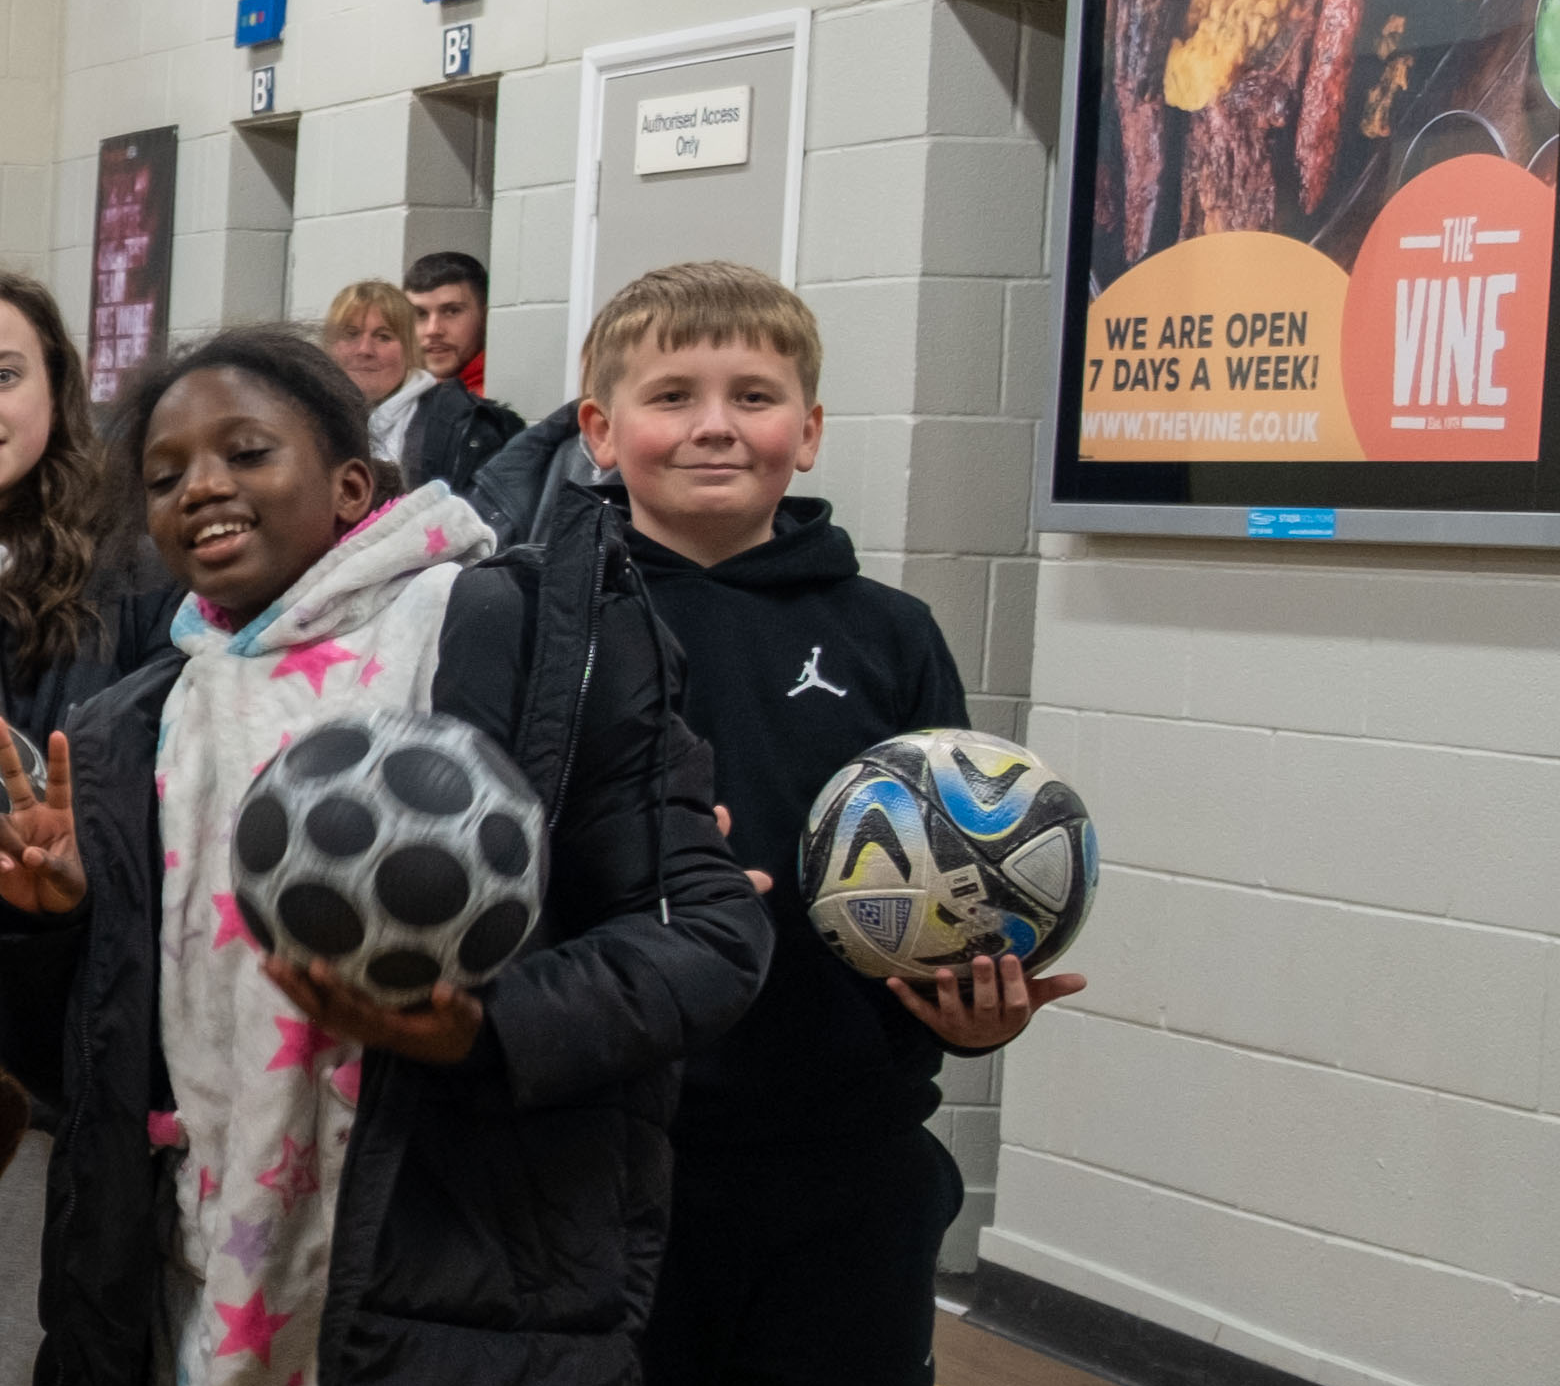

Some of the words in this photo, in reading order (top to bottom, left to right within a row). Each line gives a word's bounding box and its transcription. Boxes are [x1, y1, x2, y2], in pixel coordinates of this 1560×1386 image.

[641, 108, 698, 134] Authorised
[701, 106, 741, 126] Access
[676, 135, 700, 159] Only
[1443, 217, 1478, 263] THE
[1106, 317, 1148, 351] WE
[1158, 314, 1214, 350] ARE
[1226, 311, 1308, 348] OPEN
[1393, 273, 1517, 406] VINE
[1088, 359, 1104, 392] 7
[1112, 356, 1180, 392] DAYS
[1189, 357, 1211, 391] A
[1225, 354, 1319, 391] WEEK!
[1081, 410, 1319, 443] WWW.THEVINE.CO.UK
